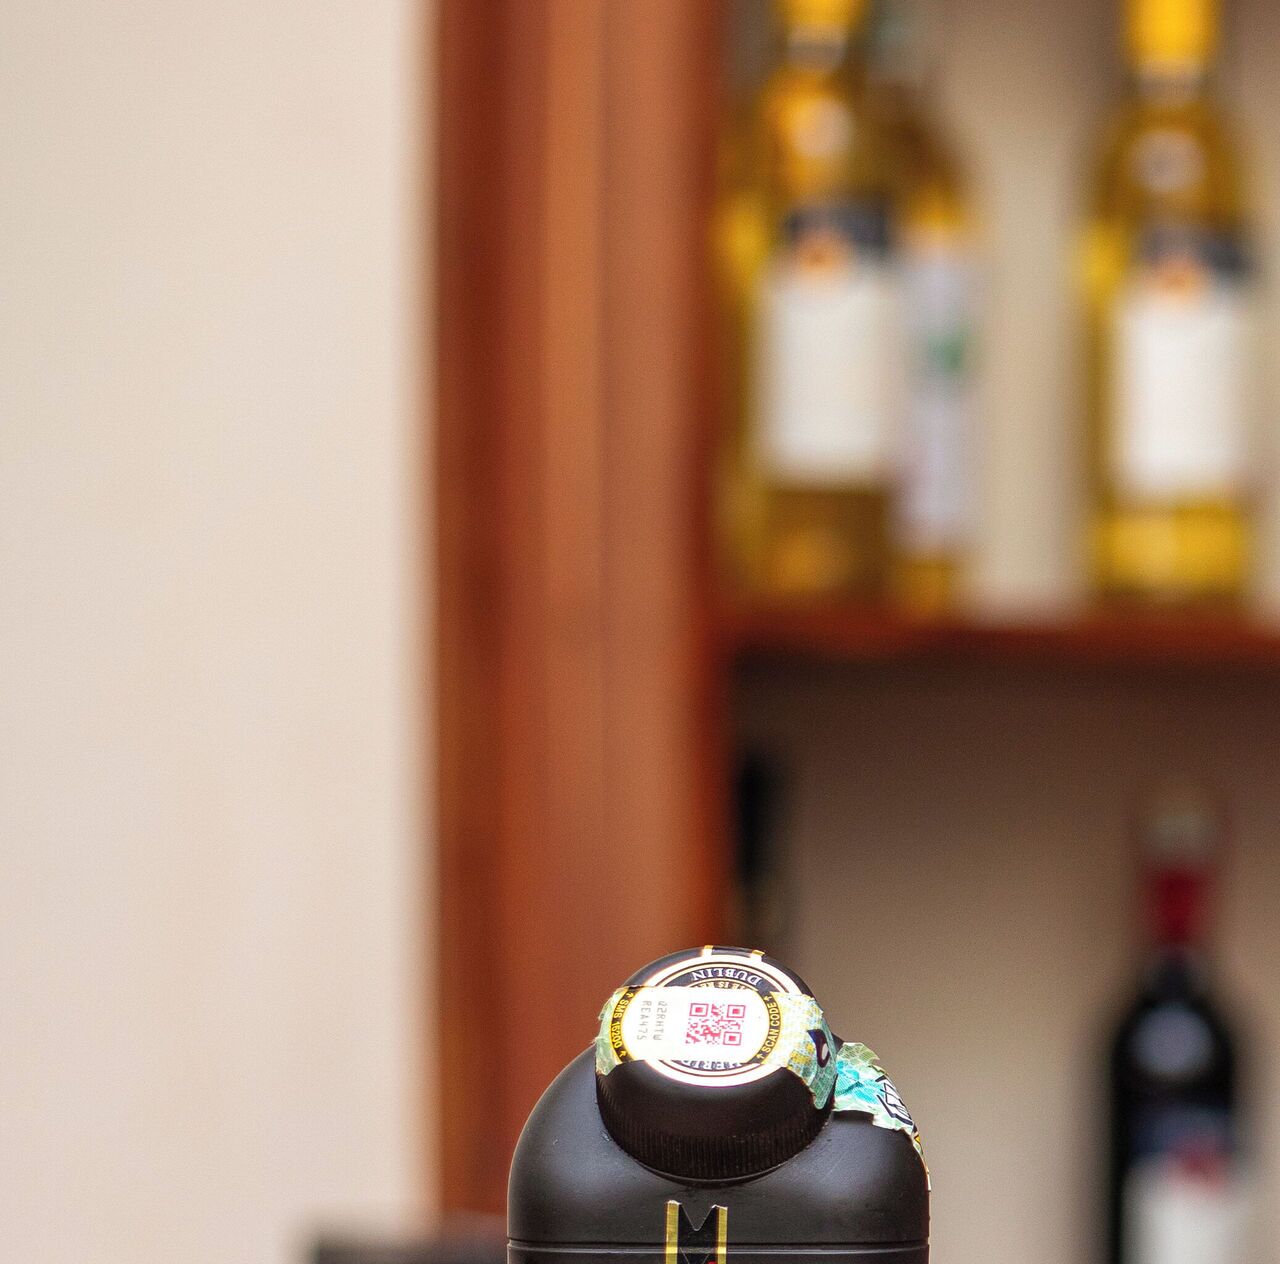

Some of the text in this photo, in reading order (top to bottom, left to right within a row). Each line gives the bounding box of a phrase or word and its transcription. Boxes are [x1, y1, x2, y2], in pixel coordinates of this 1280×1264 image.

[692, 967, 763, 986] DUBLIN
[613, 999, 630, 1019] SMS
[762, 999, 781, 1052] SCAN CODE
